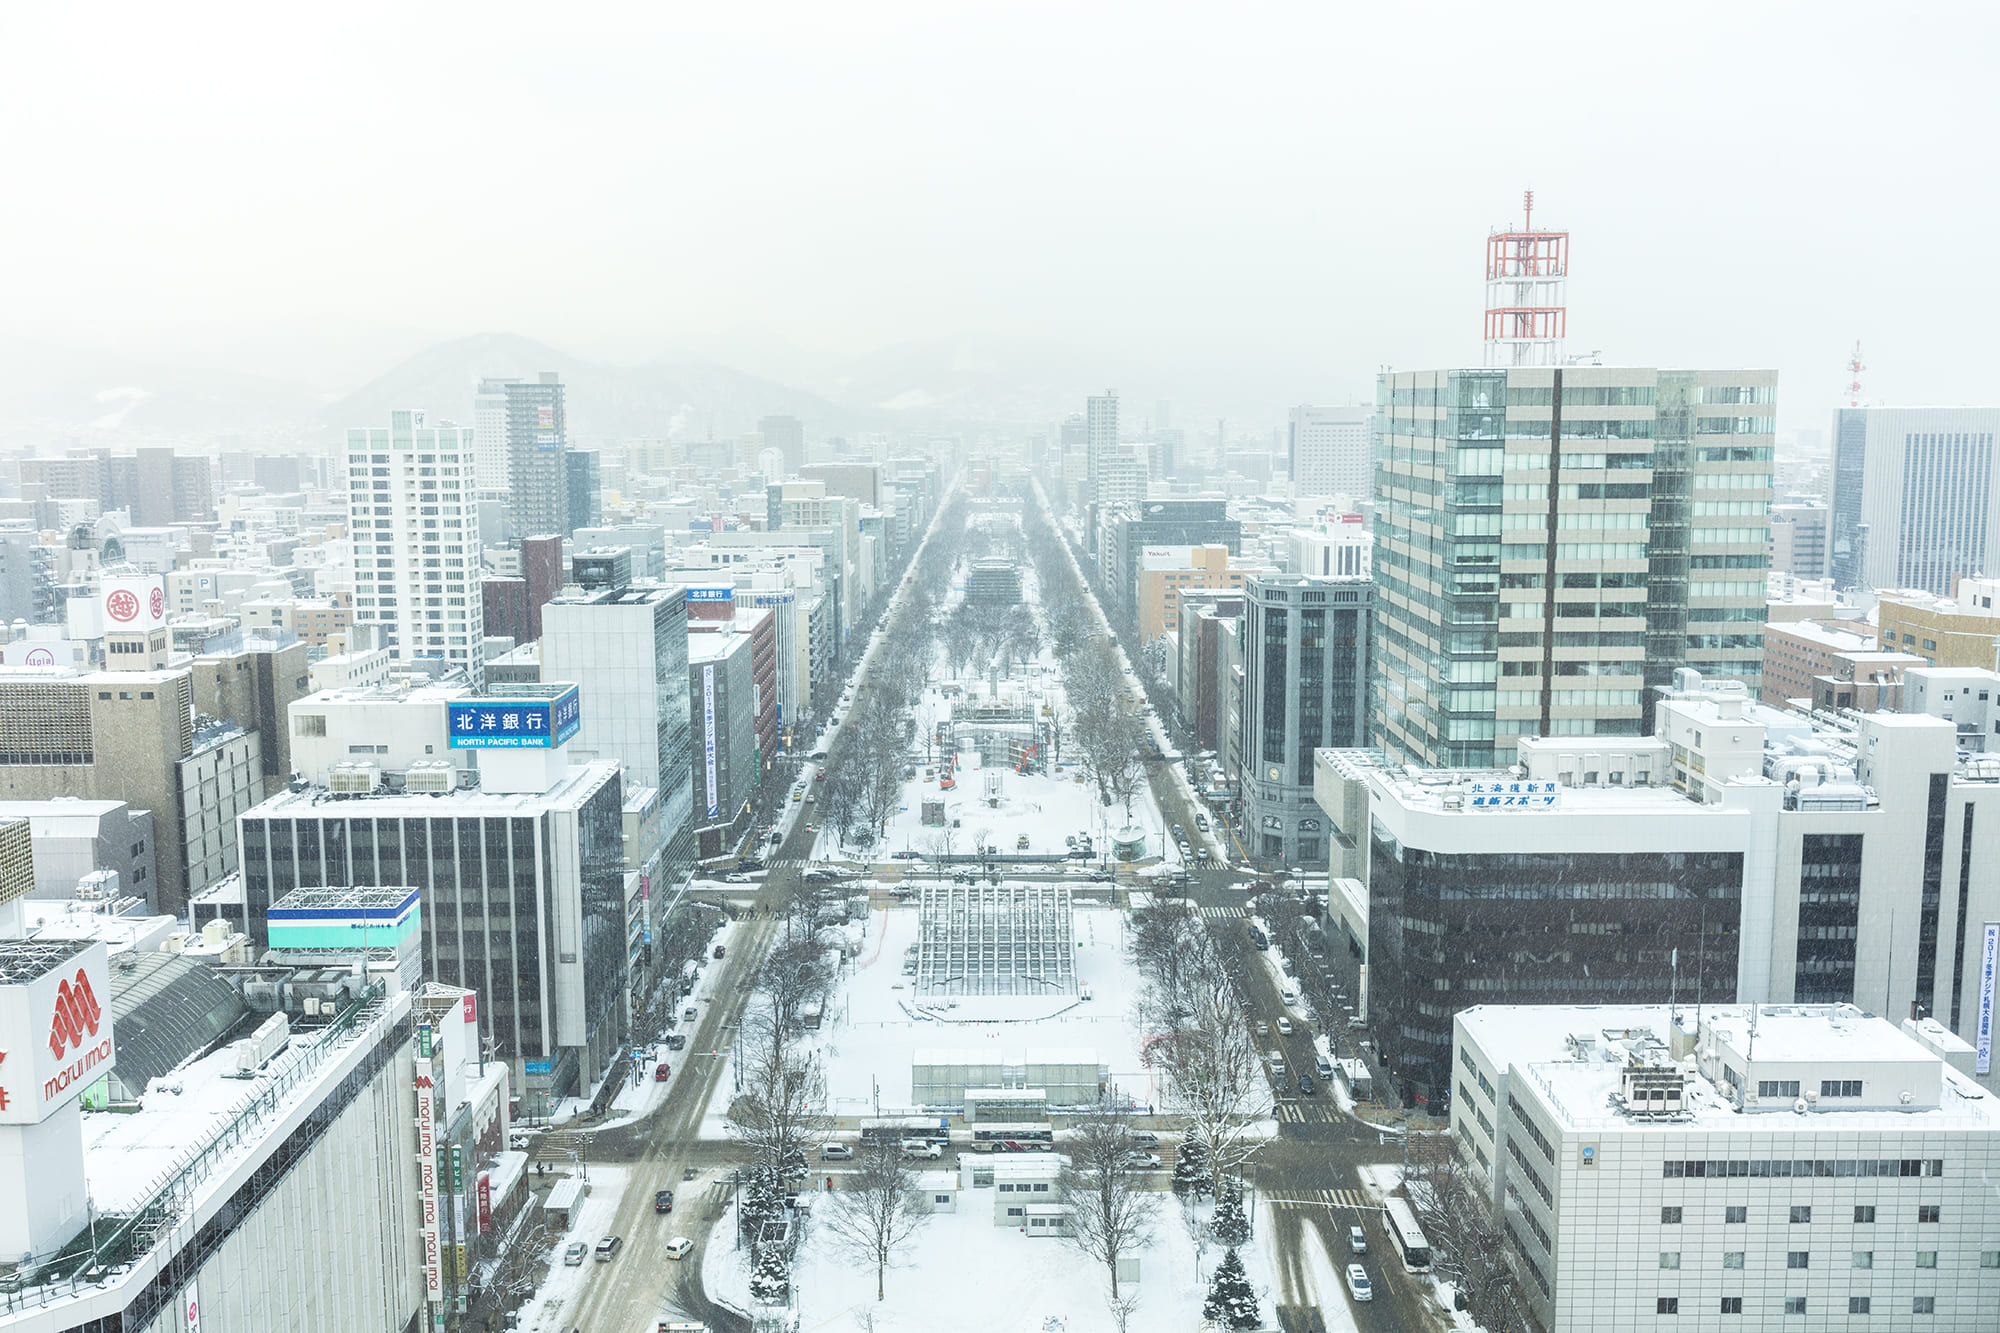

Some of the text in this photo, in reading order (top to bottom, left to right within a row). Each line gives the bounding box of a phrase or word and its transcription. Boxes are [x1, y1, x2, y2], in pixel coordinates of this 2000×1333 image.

[200, 578, 209, 588] P
[457, 713, 543, 730] 北洋銀行
[457, 738, 544, 746] NORTH PACIFIC BANK
[1472, 783, 1556, 793] 北海道新聞
[1472, 795, 1556, 806] 道新スポーツ
[44, 1058, 83, 1101] marui
[85, 1037, 112, 1071] imai
[420, 1097, 431, 1157] marui imai
[424, 1165, 435, 1224] marui imai
[427, 1231, 436, 1265] marui
[428, 1267, 438, 1291] imai
